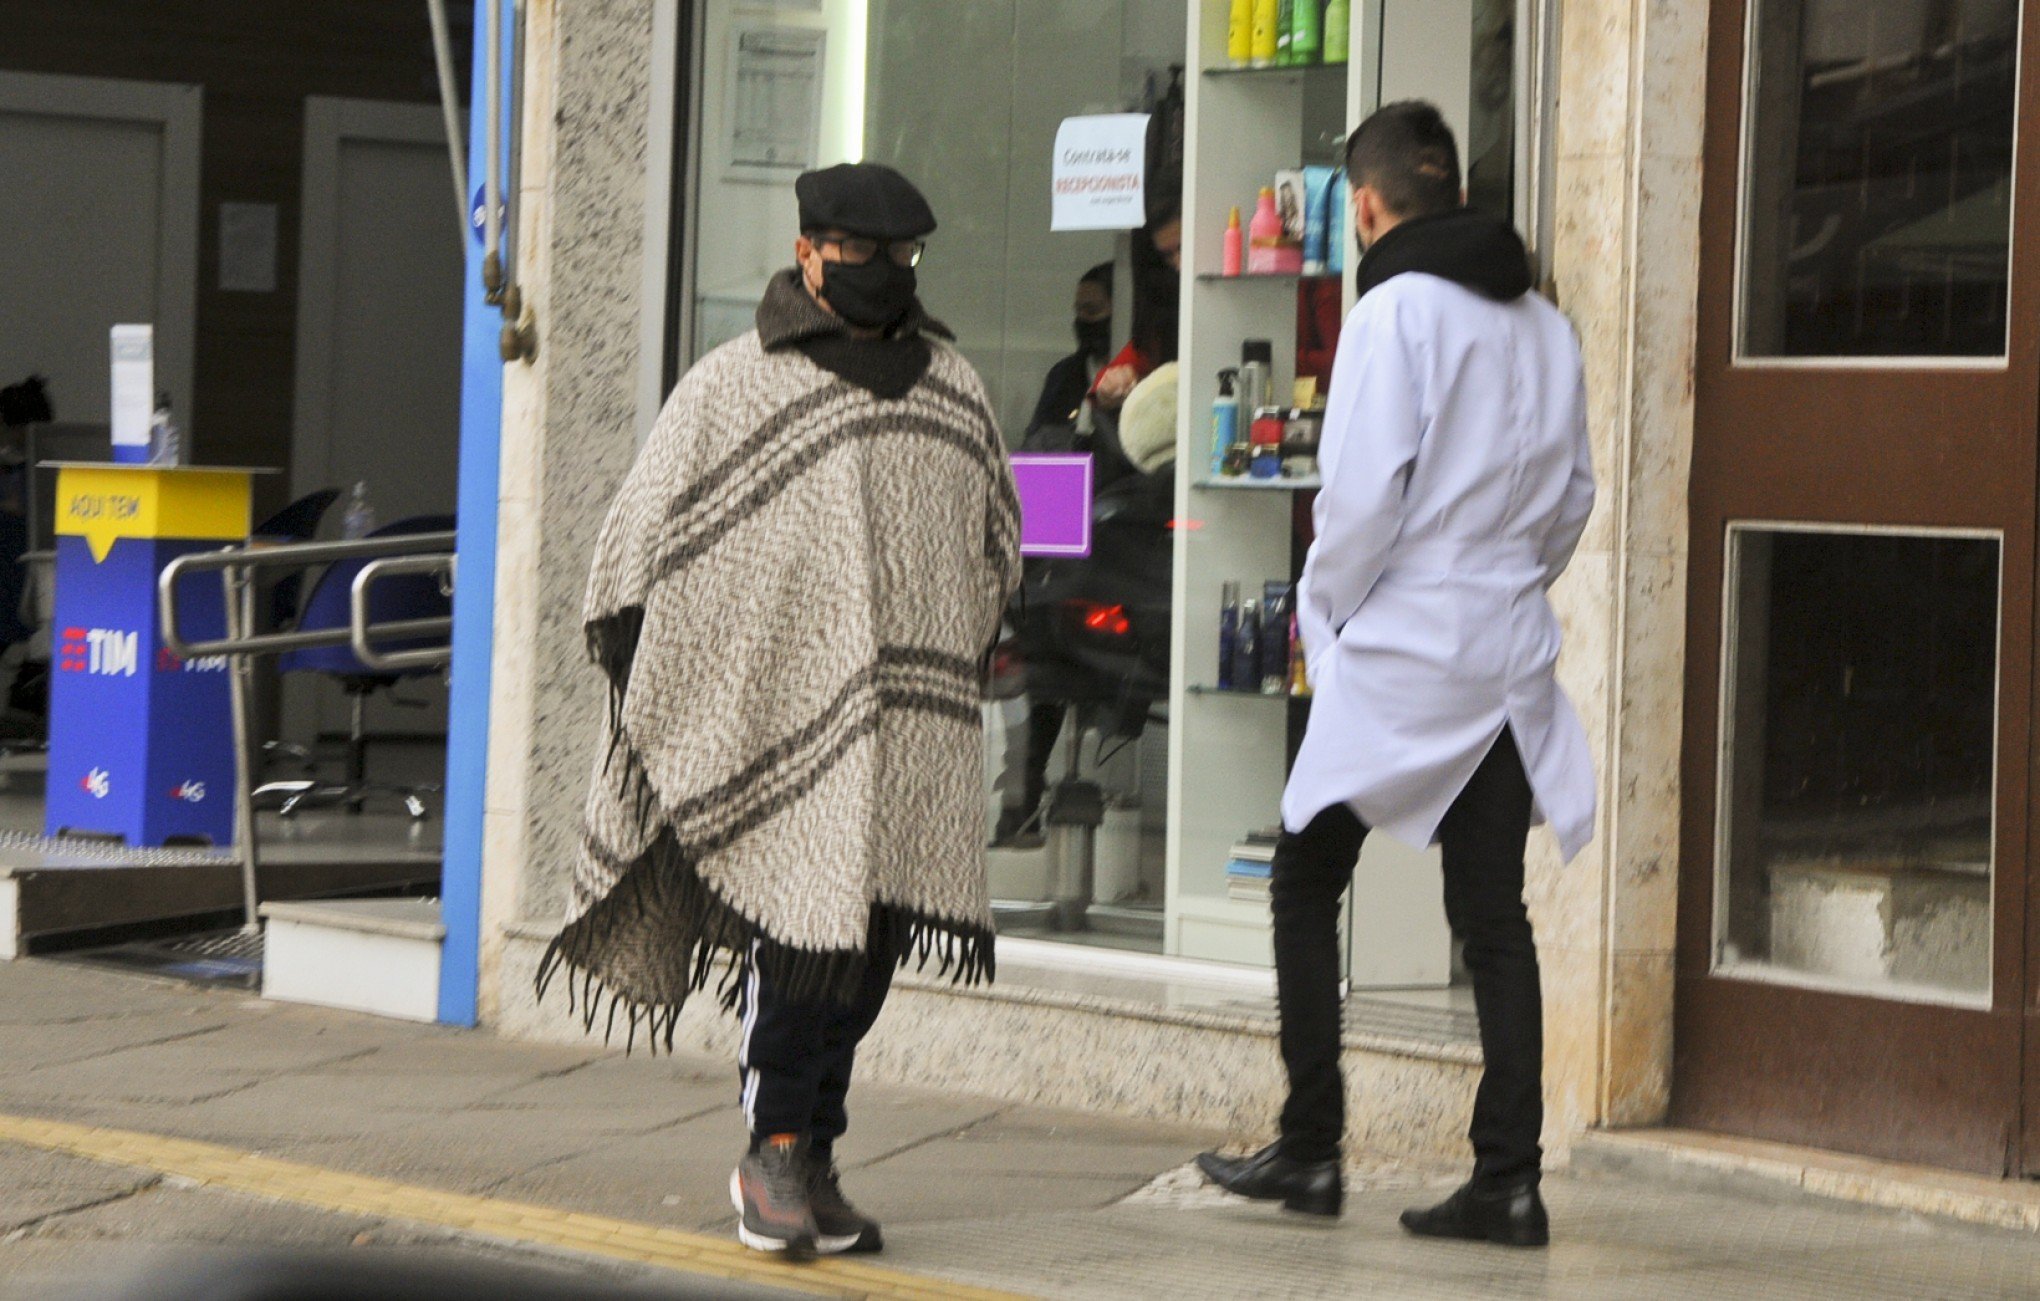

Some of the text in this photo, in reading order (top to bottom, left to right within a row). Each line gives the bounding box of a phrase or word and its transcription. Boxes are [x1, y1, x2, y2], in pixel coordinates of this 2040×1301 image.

[70, 495, 140, 522] AQUI TEM
[87, 629, 138, 677] TIM
[88, 767, 111, 798] 4G
[178, 780, 206, 802] 4G
